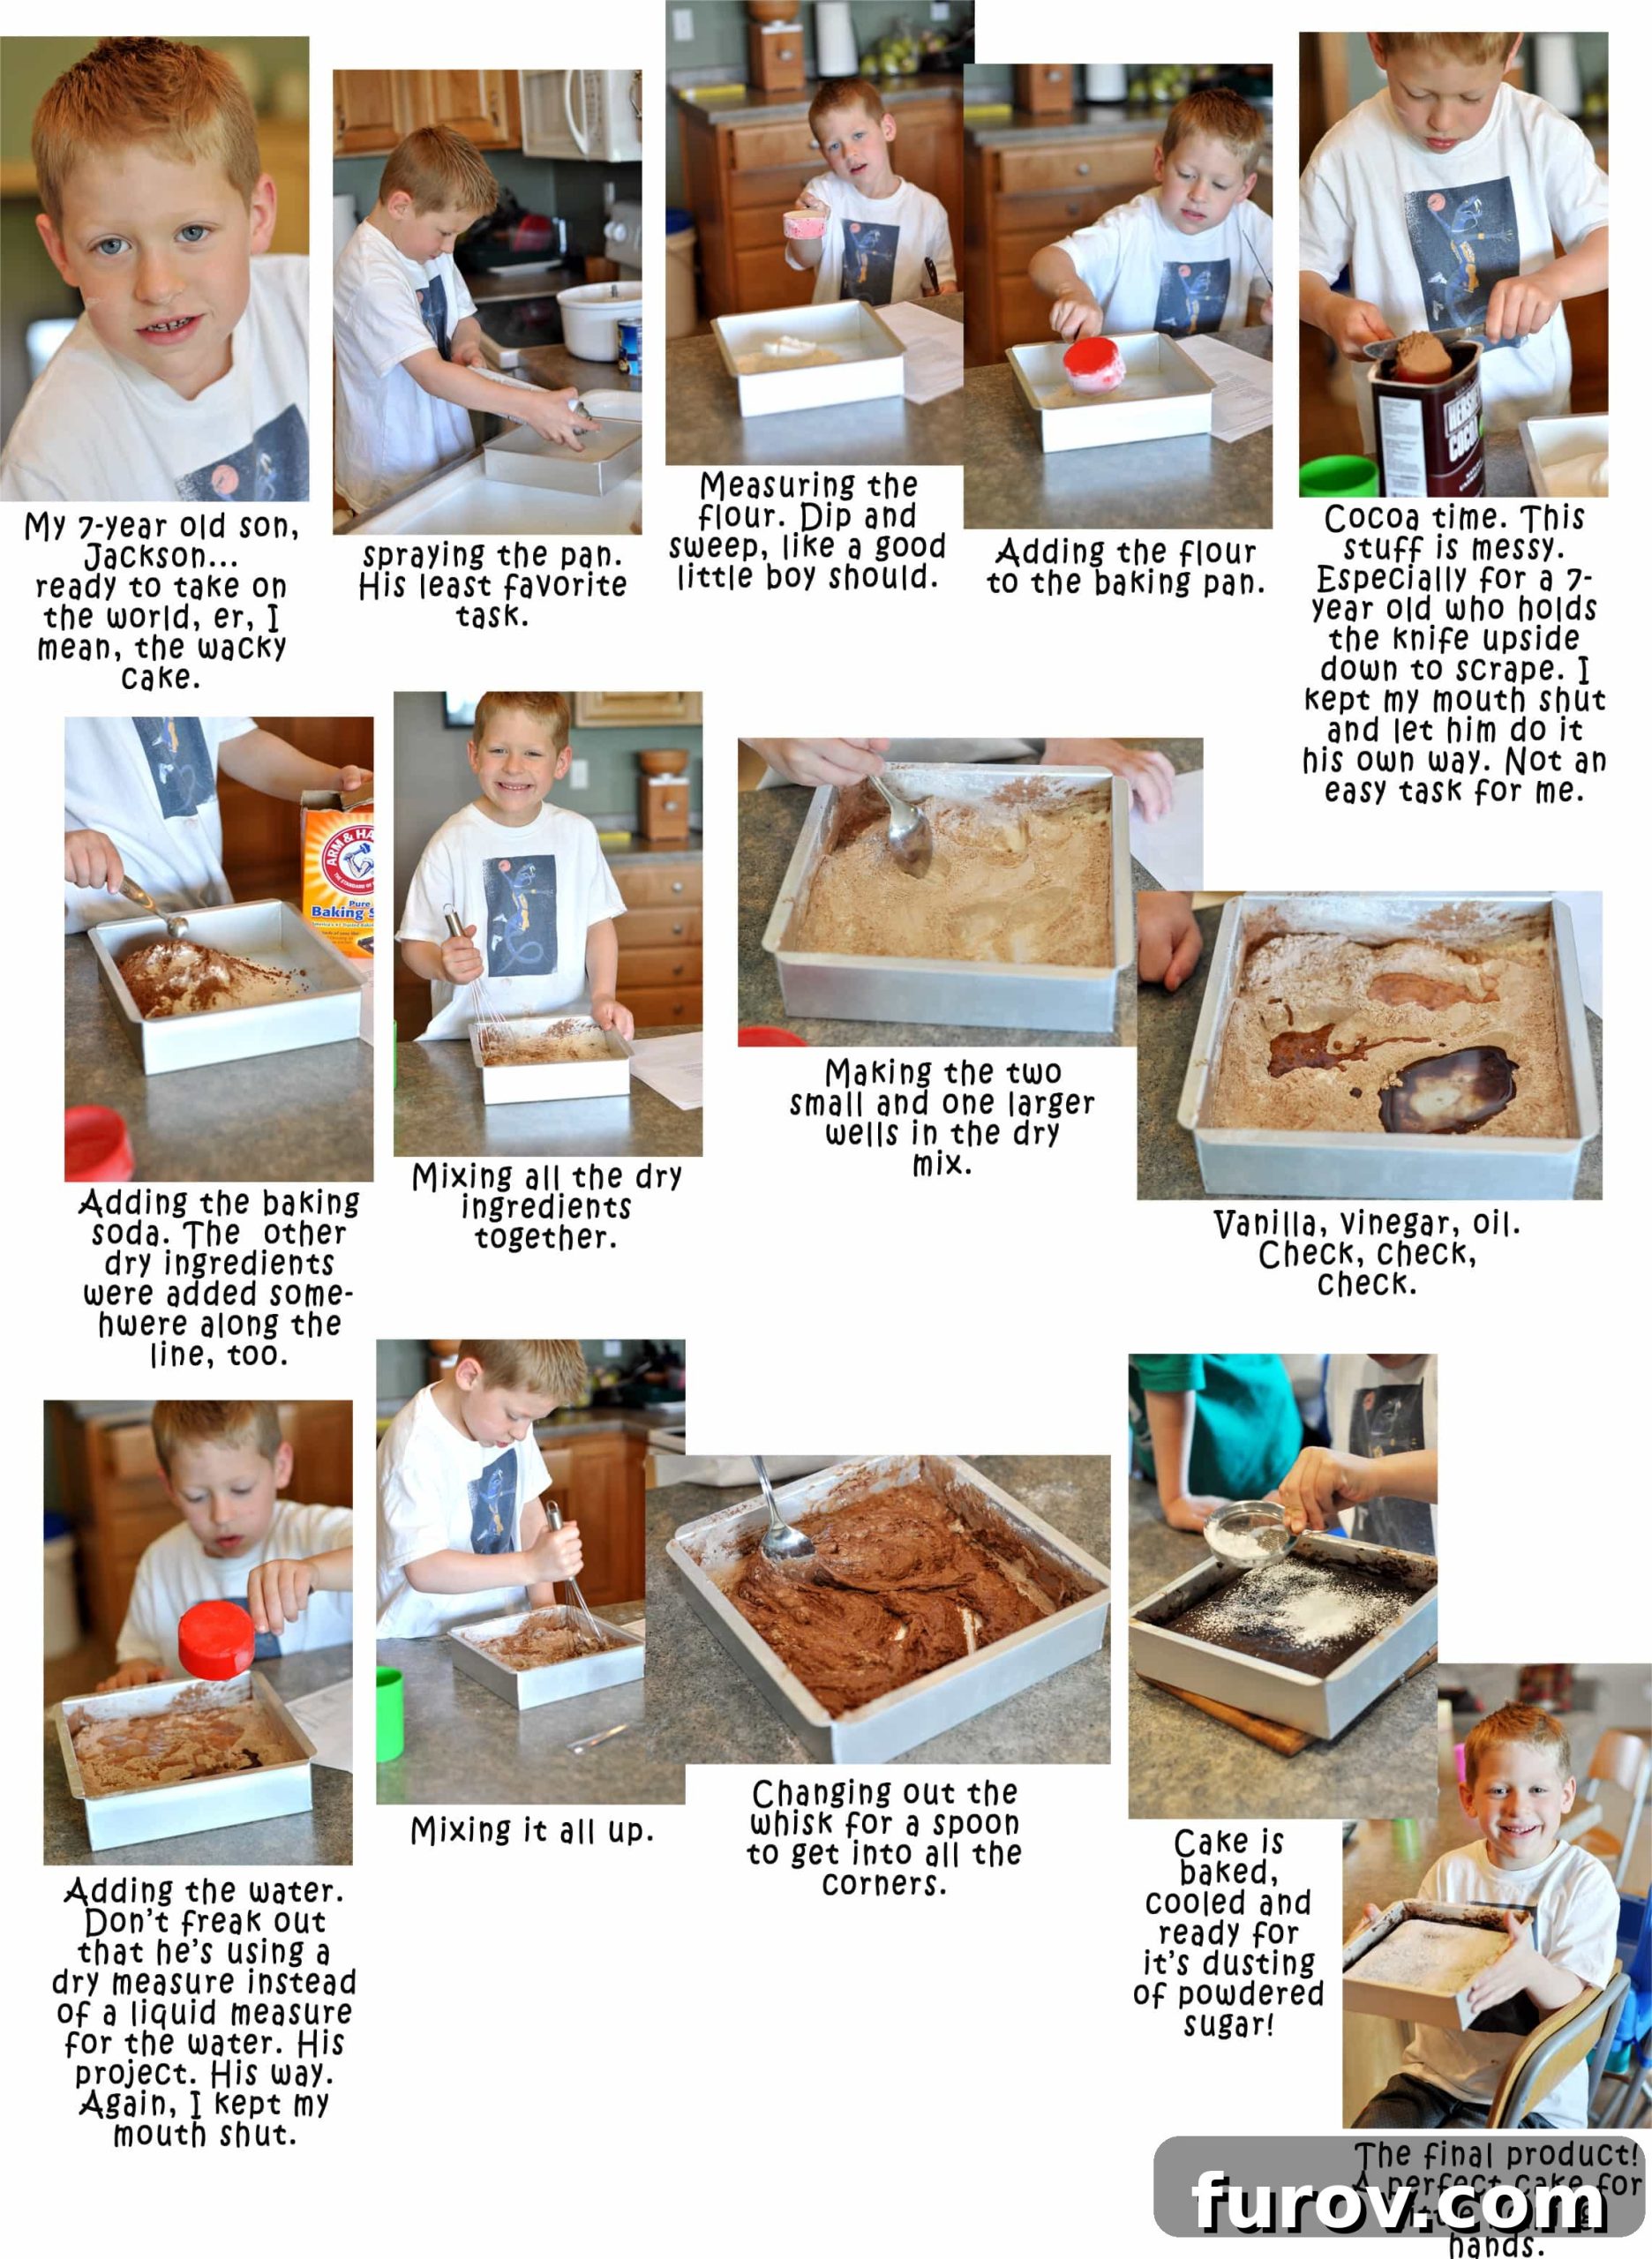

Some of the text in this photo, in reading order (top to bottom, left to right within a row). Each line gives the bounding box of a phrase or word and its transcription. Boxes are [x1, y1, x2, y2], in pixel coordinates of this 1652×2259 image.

[327, 839, 345, 867] ARM
[343, 832, 355, 844] &
[312, 905, 364, 920] Baking
